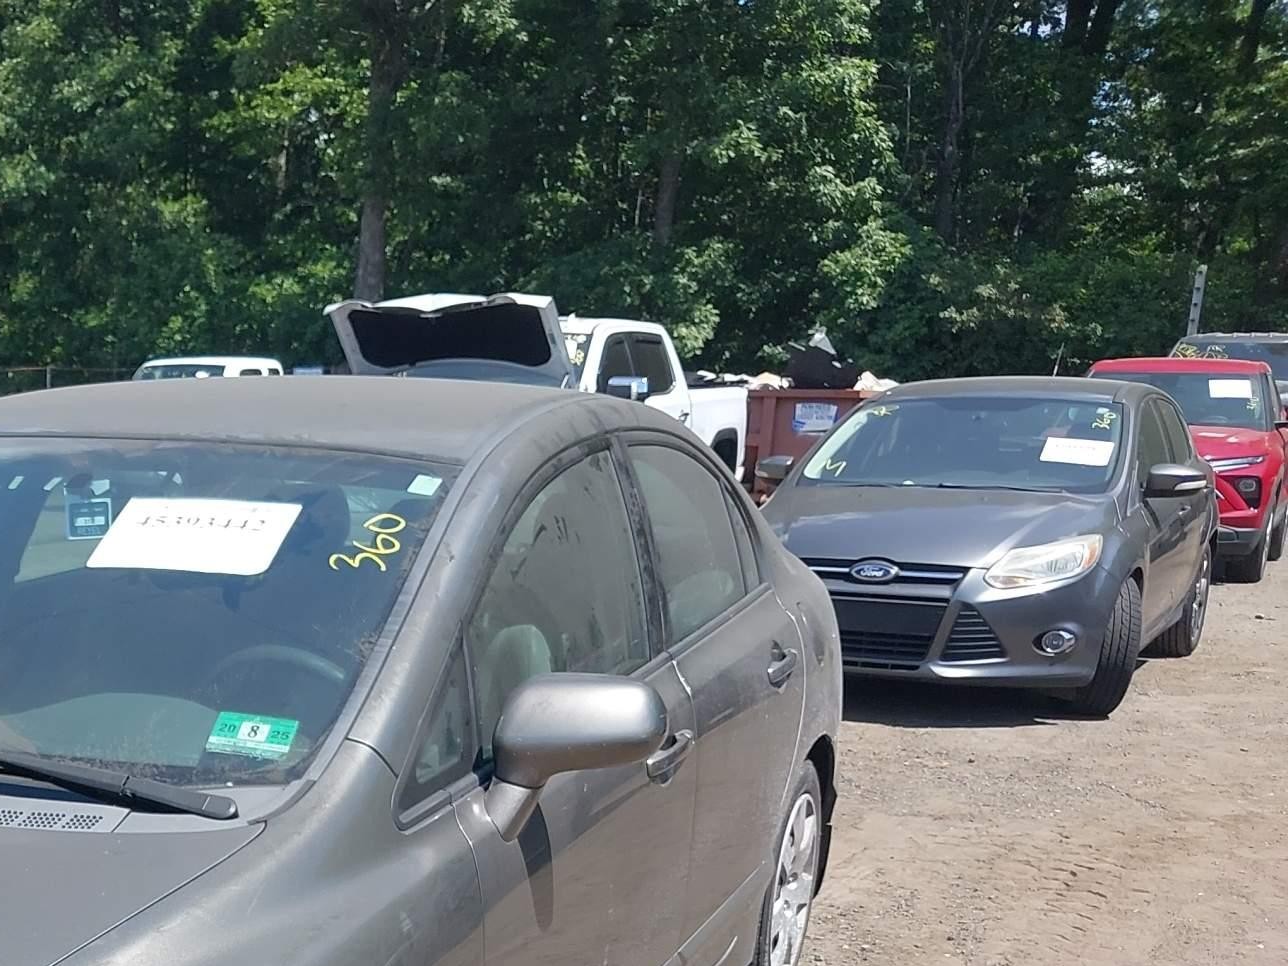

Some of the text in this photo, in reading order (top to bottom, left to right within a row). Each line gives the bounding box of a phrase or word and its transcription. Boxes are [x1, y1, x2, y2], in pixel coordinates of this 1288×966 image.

[329, 513, 406, 571] 360
[218, 723, 290, 741] 20 8 25
